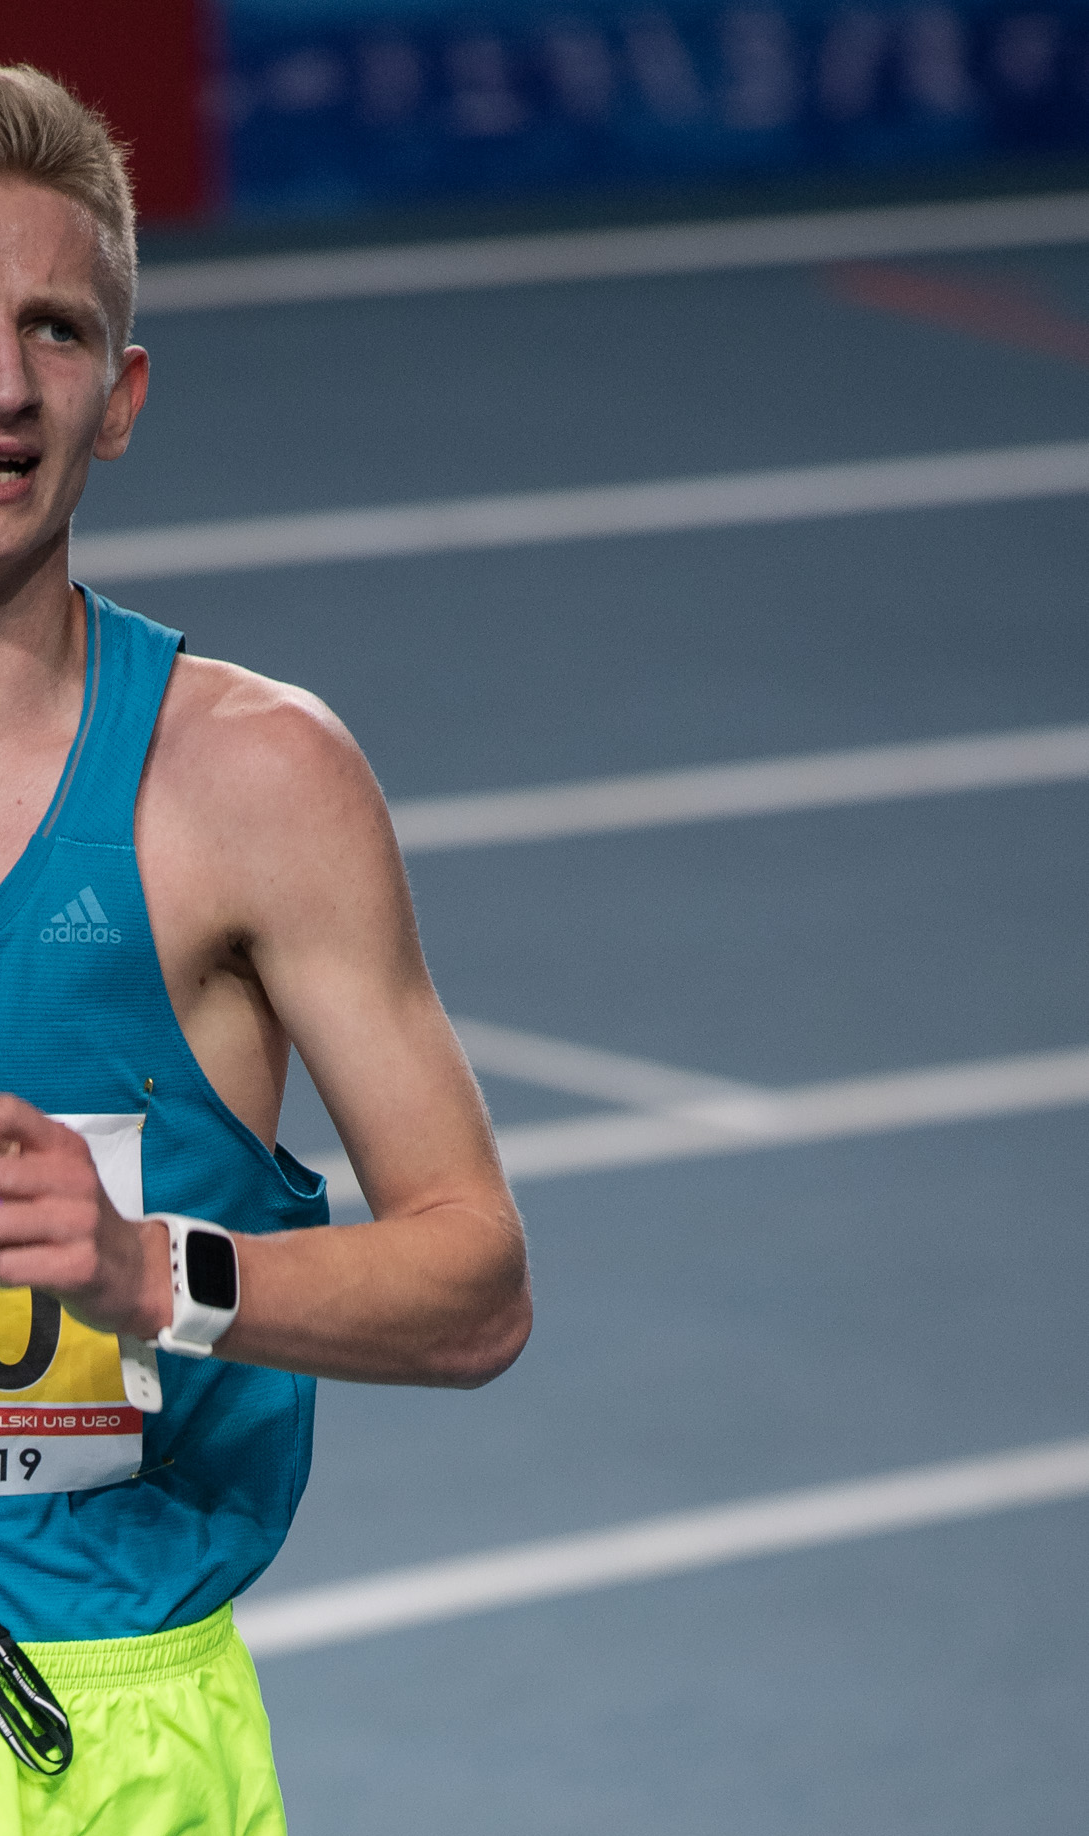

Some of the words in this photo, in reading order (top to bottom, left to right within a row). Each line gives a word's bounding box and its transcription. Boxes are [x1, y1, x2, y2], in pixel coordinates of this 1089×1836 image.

[40, 922, 122, 944] adidas
[43, 1415, 76, 1428] U18
[82, 1415, 121, 1428] U20
